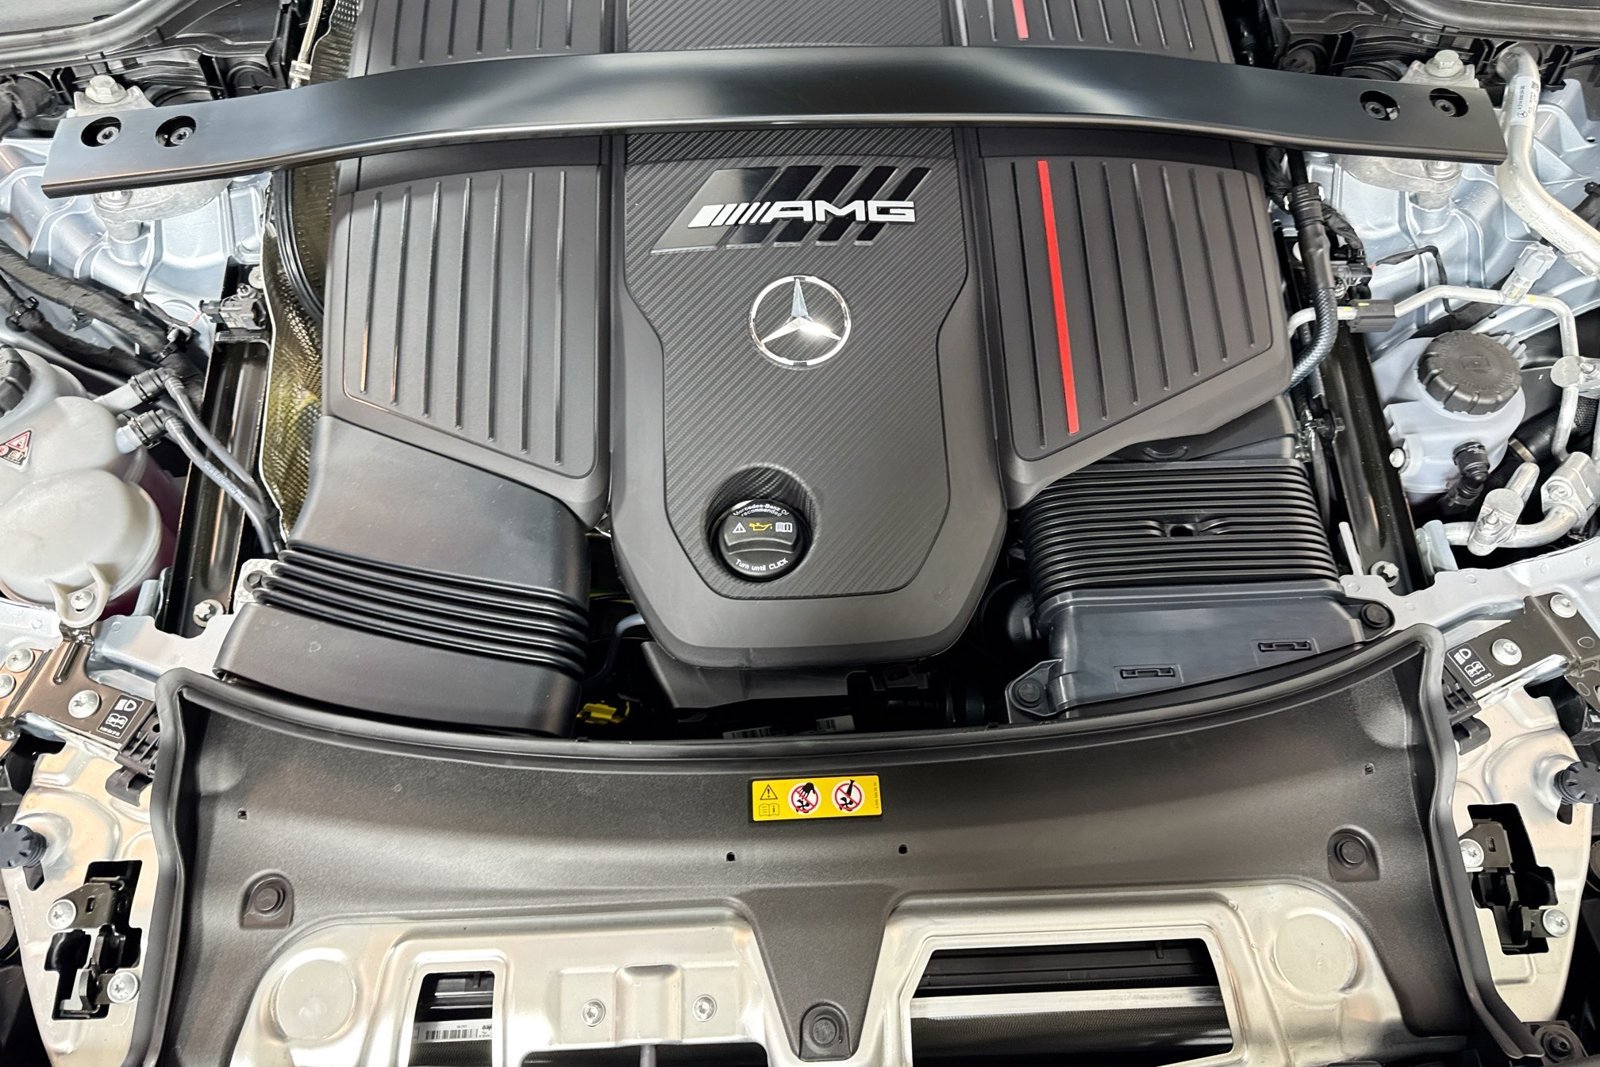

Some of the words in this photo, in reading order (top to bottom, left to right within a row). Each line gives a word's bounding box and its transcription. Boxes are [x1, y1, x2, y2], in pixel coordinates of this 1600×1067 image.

[760, 199, 916, 223] AMG
[735, 558, 750, 570] Turn
[751, 564, 767, 572] until
[769, 557, 789, 570] CLICK
